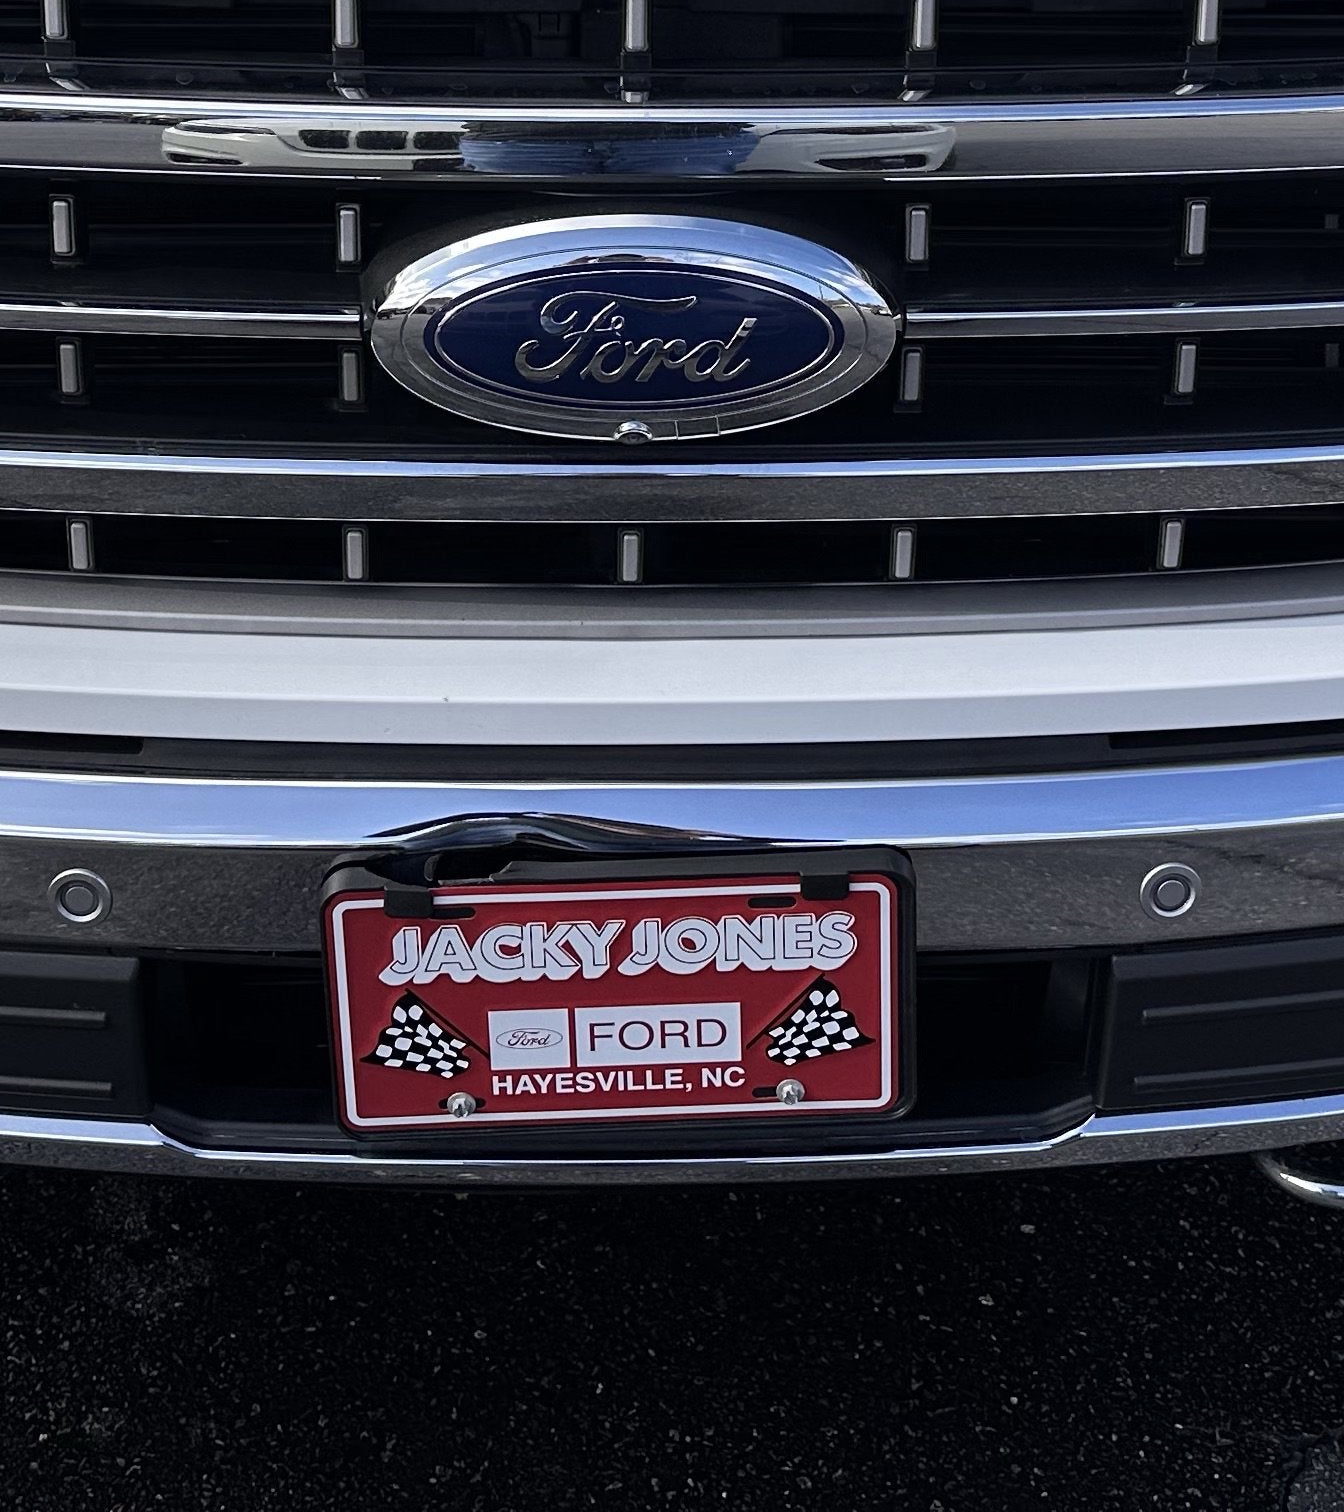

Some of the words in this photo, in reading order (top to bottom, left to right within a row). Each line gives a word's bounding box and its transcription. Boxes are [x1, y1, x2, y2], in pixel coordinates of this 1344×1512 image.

[515, 289, 758, 383] Ford
[379, 919, 626, 986] JACKY
[617, 912, 858, 976] JONES
[507, 1030, 550, 1046] Ford
[588, 1018, 729, 1052] FORD
[491, 1068, 693, 1096] HAYESVILLE,
[701, 1066, 747, 1088] NC
